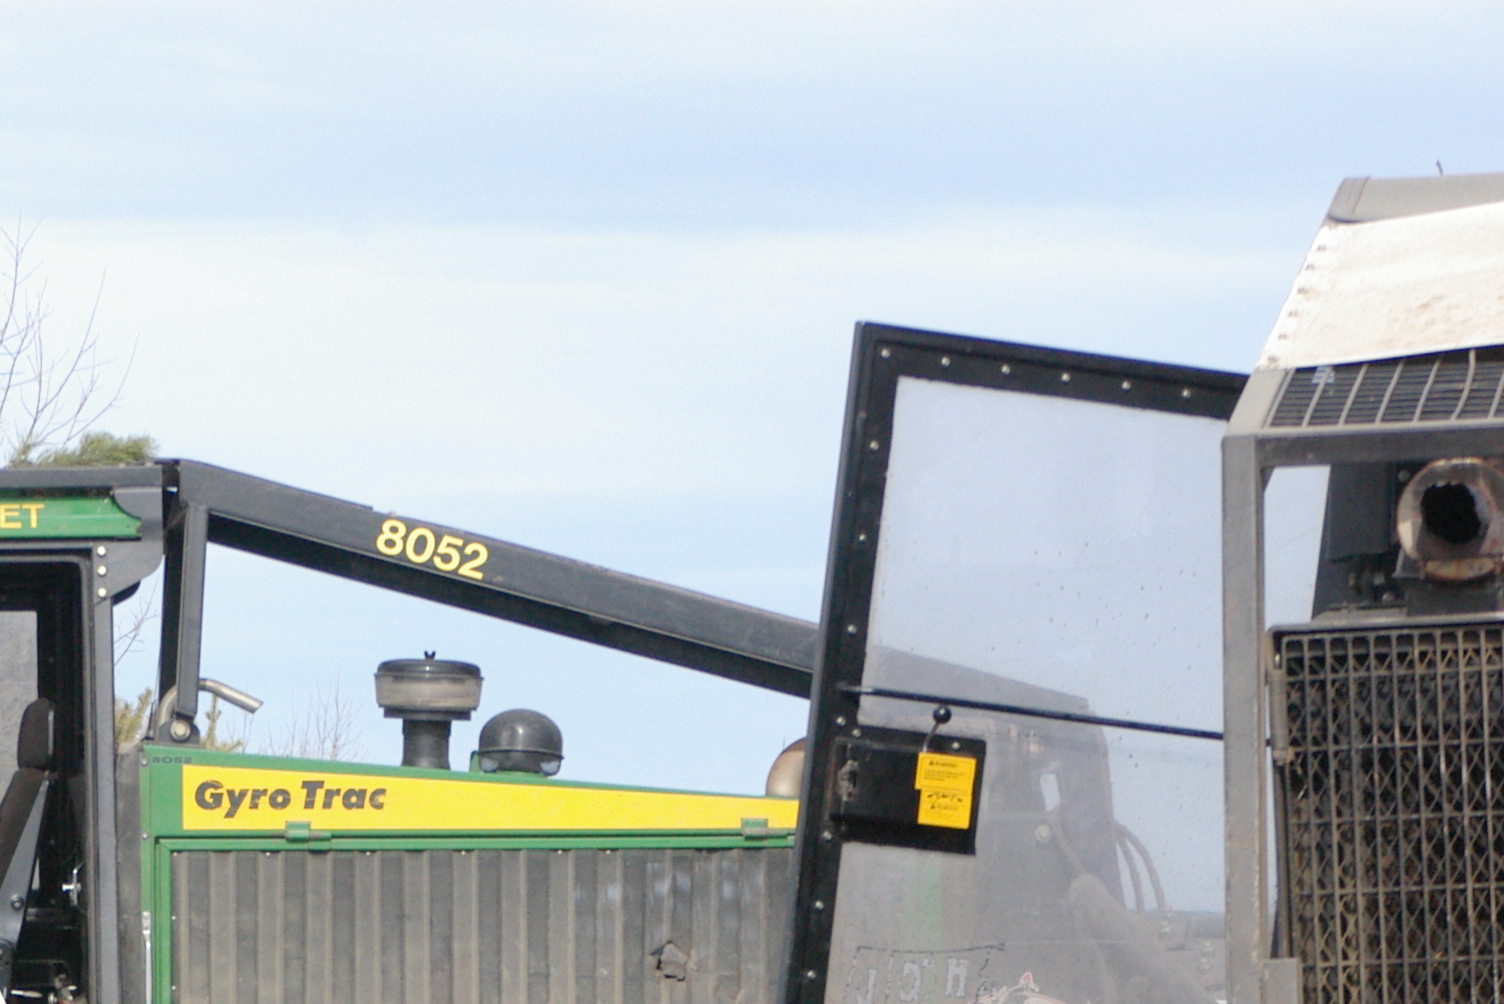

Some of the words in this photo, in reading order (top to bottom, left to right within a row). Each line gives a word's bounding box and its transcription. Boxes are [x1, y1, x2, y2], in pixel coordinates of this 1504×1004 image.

[376, 519, 488, 580] 8052
[152, 756, 193, 764] 8052
[195, 779, 291, 819] Gyro
[301, 780, 387, 810] Trac
